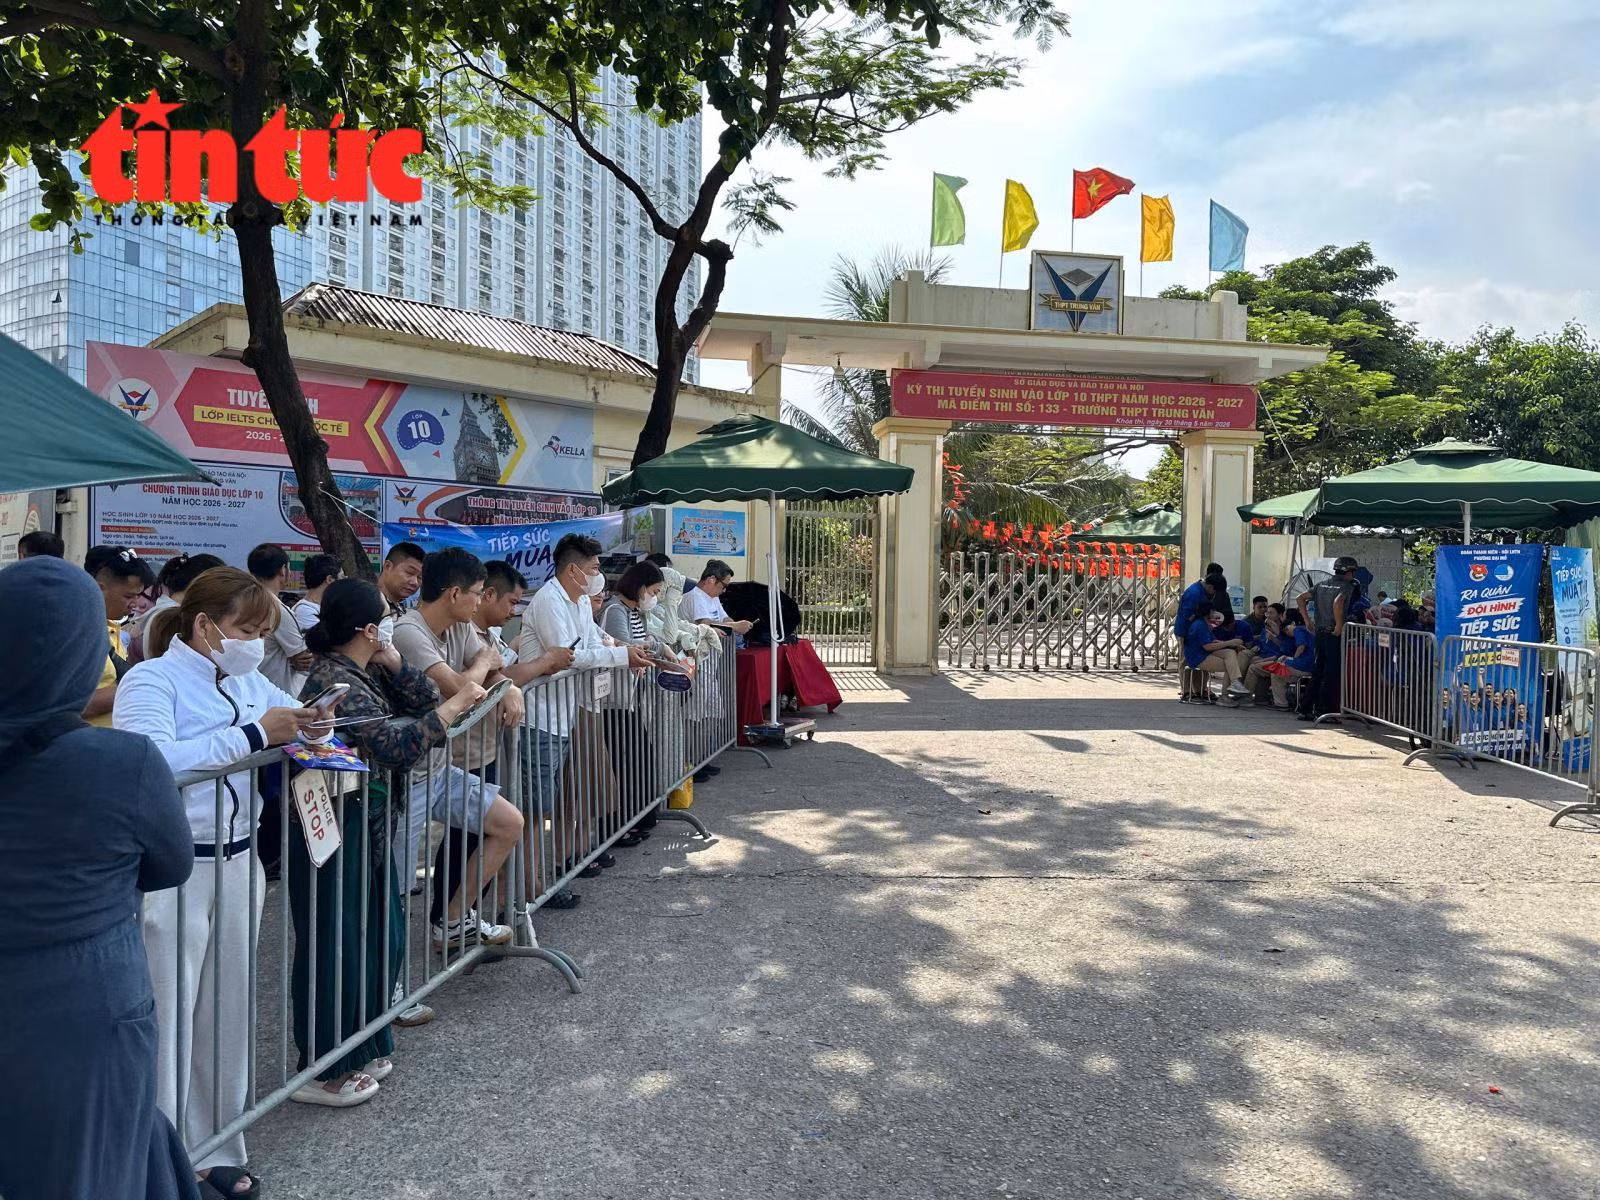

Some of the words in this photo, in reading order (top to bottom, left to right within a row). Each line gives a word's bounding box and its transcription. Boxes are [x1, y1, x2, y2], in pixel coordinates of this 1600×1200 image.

[1054, 301, 1069, 309] THPT
[1070, 302, 1088, 310] TRUNG
[906, 384, 922, 395] KỲ
[926, 385, 944, 395] THI
[949, 384, 985, 398] TUYỂN
[989, 388, 1018, 399] SINH
[1021, 388, 1044, 400] VÀO
[1047, 388, 1069, 401] LỚP
[1074, 392, 1087, 402] 10
[1091, 393, 1119, 403] THPT
[1122, 392, 1149, 404] NĂM
[1152, 395, 1175, 407] HỌC
[1178, 396, 1206, 406] 2026
[1216, 398, 1243, 408] 2027
[960, 398, 990, 411] ĐIỂM
[994, 402, 1012, 412] THI
[1015, 400, 1035, 413] SỐ:
[1039, 403, 1060, 413] 133
[1071, 404, 1117, 416] TRƯỜNG
[1120, 407, 1148, 417] THPT
[1151, 408, 1189, 418] TRUNG
[1192, 408, 1215, 419] VĂN
[201, 409, 224, 420] LỚP
[226, 412, 255, 423] IELTS
[330, 422, 343, 433] TẾ
[407, 420, 431, 439] 10
[246, 430, 271, 440] 2026
[559, 445, 585, 457] KELLA
[143, 483, 175, 494] CHƯƠNG
[177, 485, 200, 496] TRÌNH
[202, 486, 219, 497] GIÁO
[221, 488, 237, 499] DỤC
[238, 489, 253, 499] LỚP
[255, 491, 264, 499] 10
[162, 496, 181, 505] NĂM
[183, 498, 201, 507] HỌC
[228, 500, 246, 508] 2027
[467, 495, 495, 508] THÔNG
[496, 498, 509, 509] TIN
[511, 498, 536, 512] TUYỂN
[537, 502, 555, 513] SINH
[555, 502, 571, 514] VÀO
[572, 504, 587, 516] LỚP
[587, 506, 597, 516] 10
[488, 531, 519, 553] TIẾP
[523, 527, 551, 547] SỨC
[505, 544, 552, 569] MÙA
[1555, 565, 1570, 583] TIẾP
[1460, 589, 1478, 602] RA
[1481, 584, 1513, 598] QUÂN
[1467, 604, 1487, 616] ĐỘI
[1490, 602, 1517, 613] HÌNH
[1460, 618, 1489, 636] TIẾP
[1492, 615, 1521, 632] SỨC
[303, 789, 325, 841] STOP
[318, 786, 334, 826] POLICE
